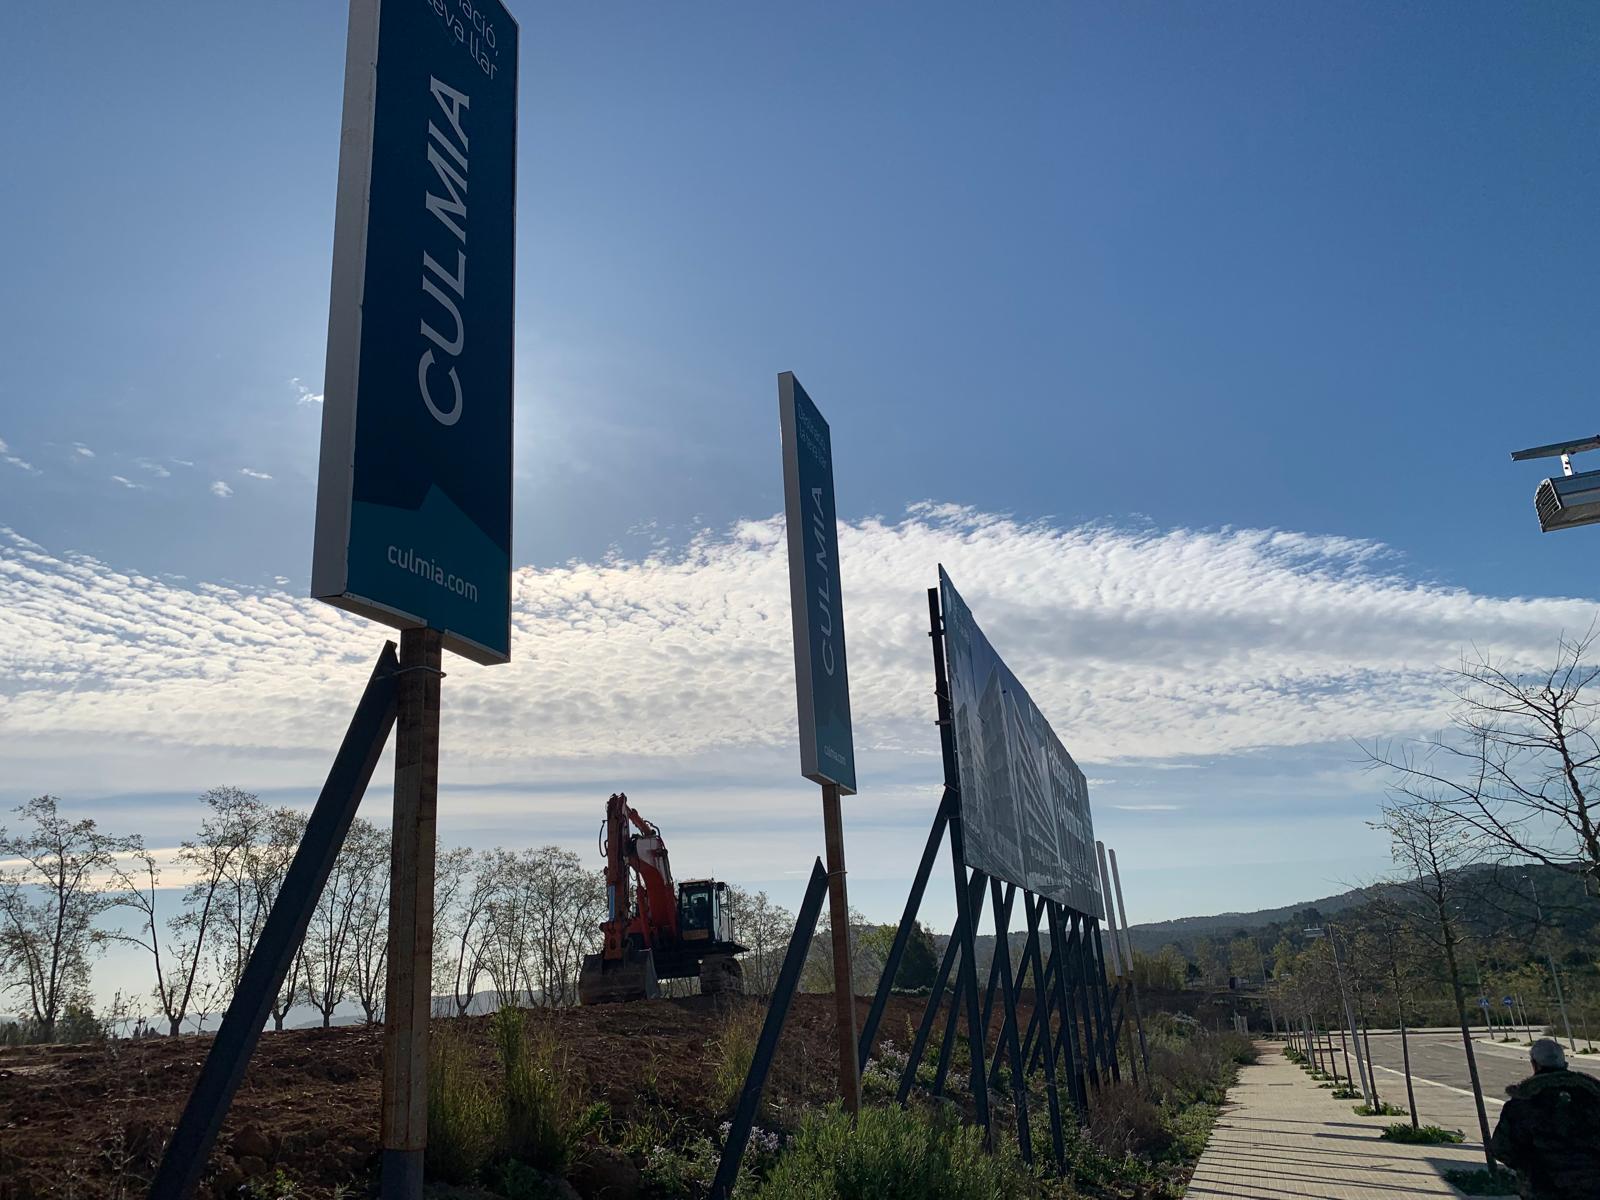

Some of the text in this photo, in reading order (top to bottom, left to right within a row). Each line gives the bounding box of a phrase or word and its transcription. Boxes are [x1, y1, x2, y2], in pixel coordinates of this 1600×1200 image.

[428, 0, 498, 80] eva llar
[459, 0, 498, 56] ació,
[418, 73, 470, 426] CULMIA
[387, 545, 478, 603] culmia.com
[811, 487, 835, 677] CULMIA
